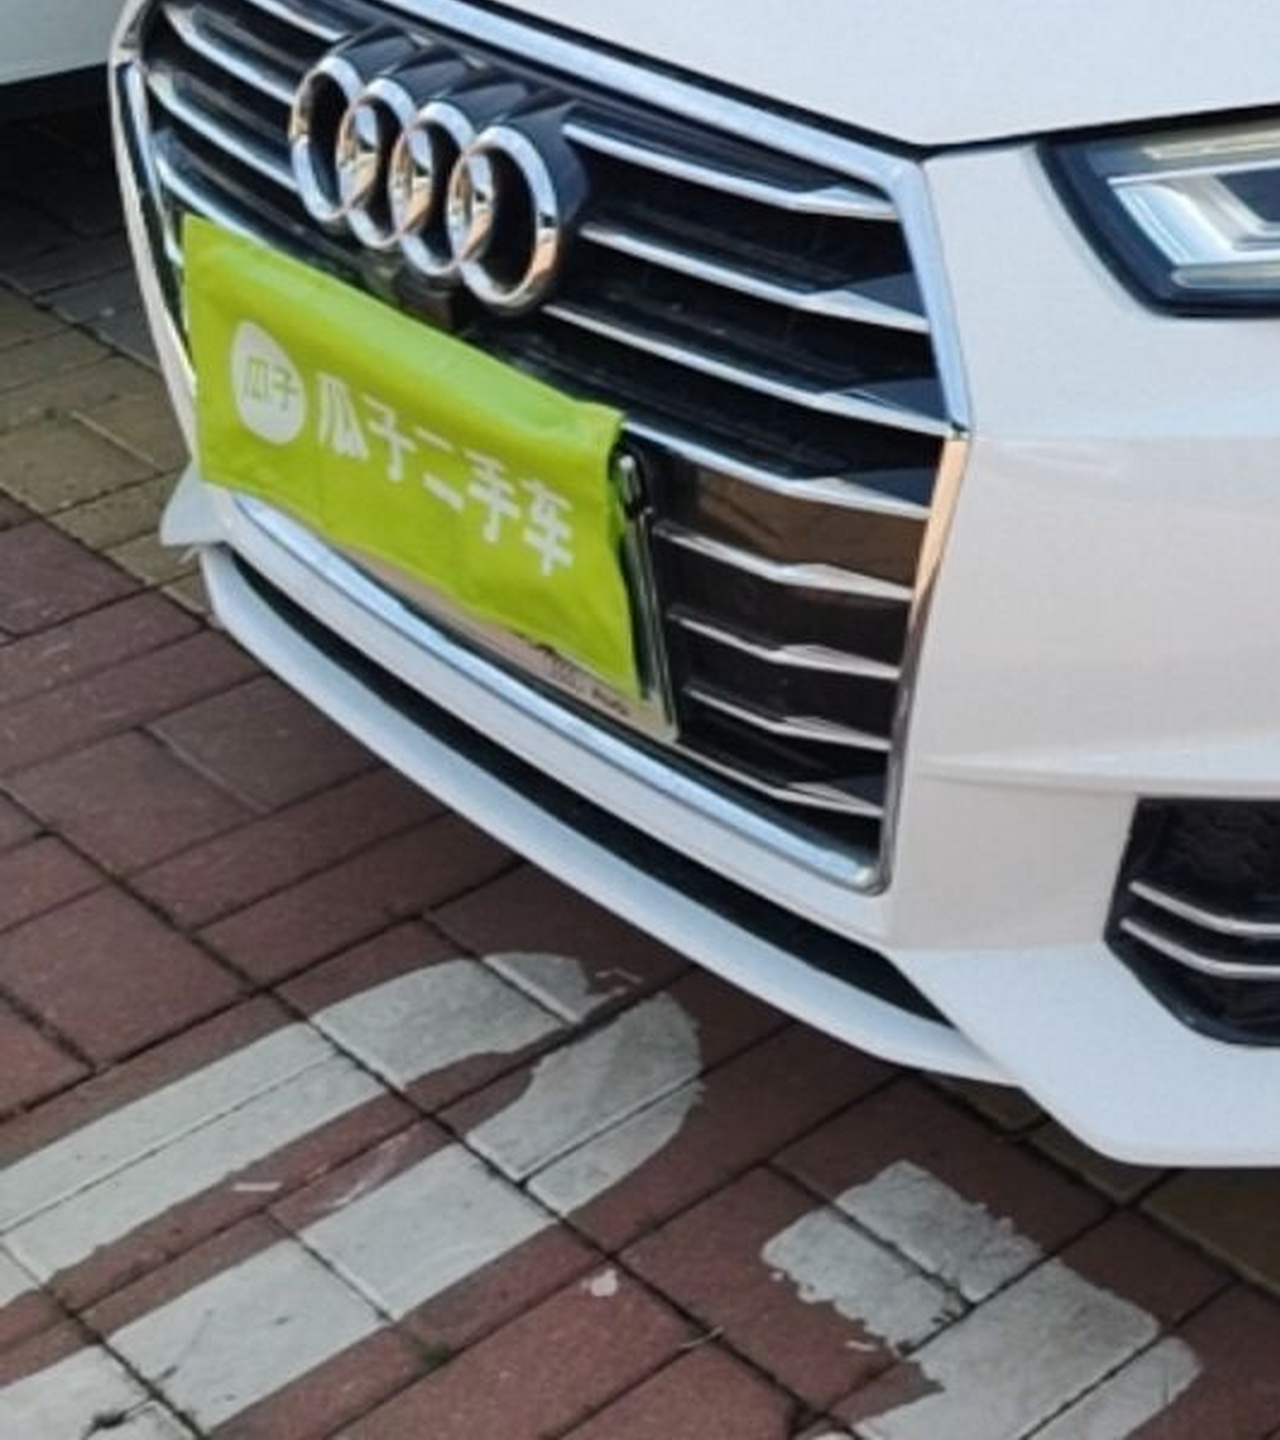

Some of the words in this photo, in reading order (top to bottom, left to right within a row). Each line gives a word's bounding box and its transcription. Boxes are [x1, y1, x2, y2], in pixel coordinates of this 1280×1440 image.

[315, 369, 574, 578] 瓜子二手车
